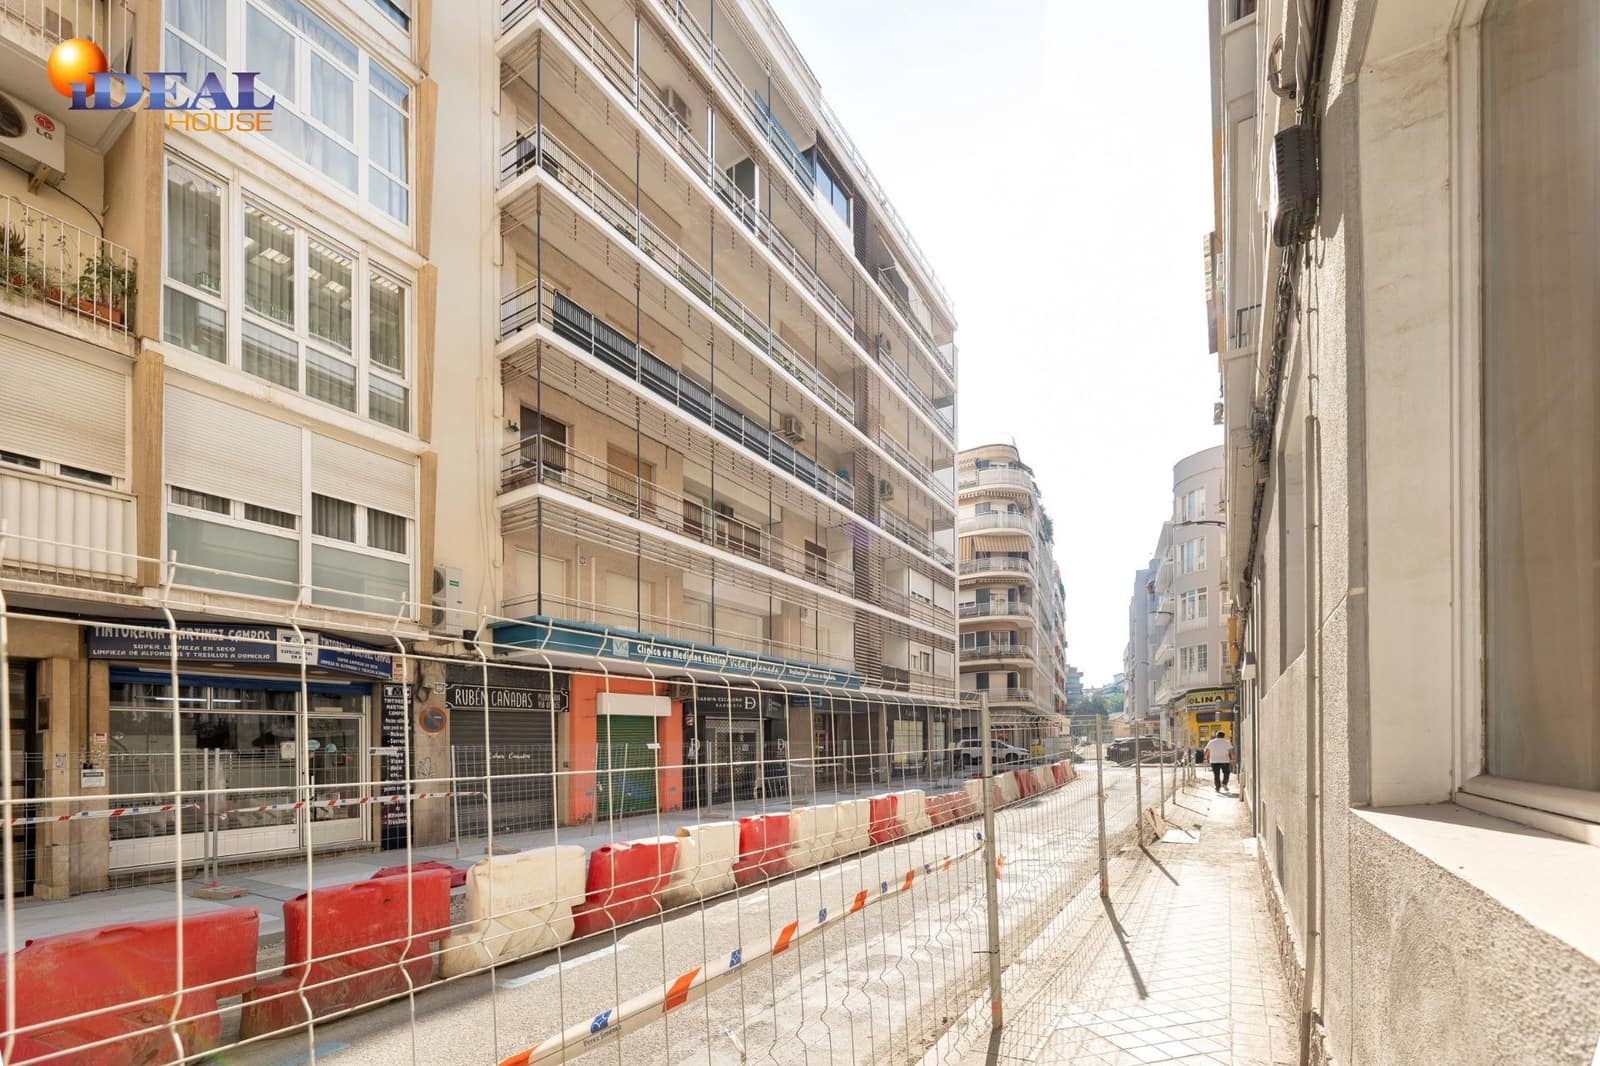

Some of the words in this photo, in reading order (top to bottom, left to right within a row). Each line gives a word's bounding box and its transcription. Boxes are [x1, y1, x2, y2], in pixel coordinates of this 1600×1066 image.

[36, 127, 53, 141] LG
[171, 627, 224, 641] ARTINEZ
[662, 647, 672, 657] de
[455, 688, 486, 706] RUBÉN
[491, 690, 533, 708] CAÑADAS
